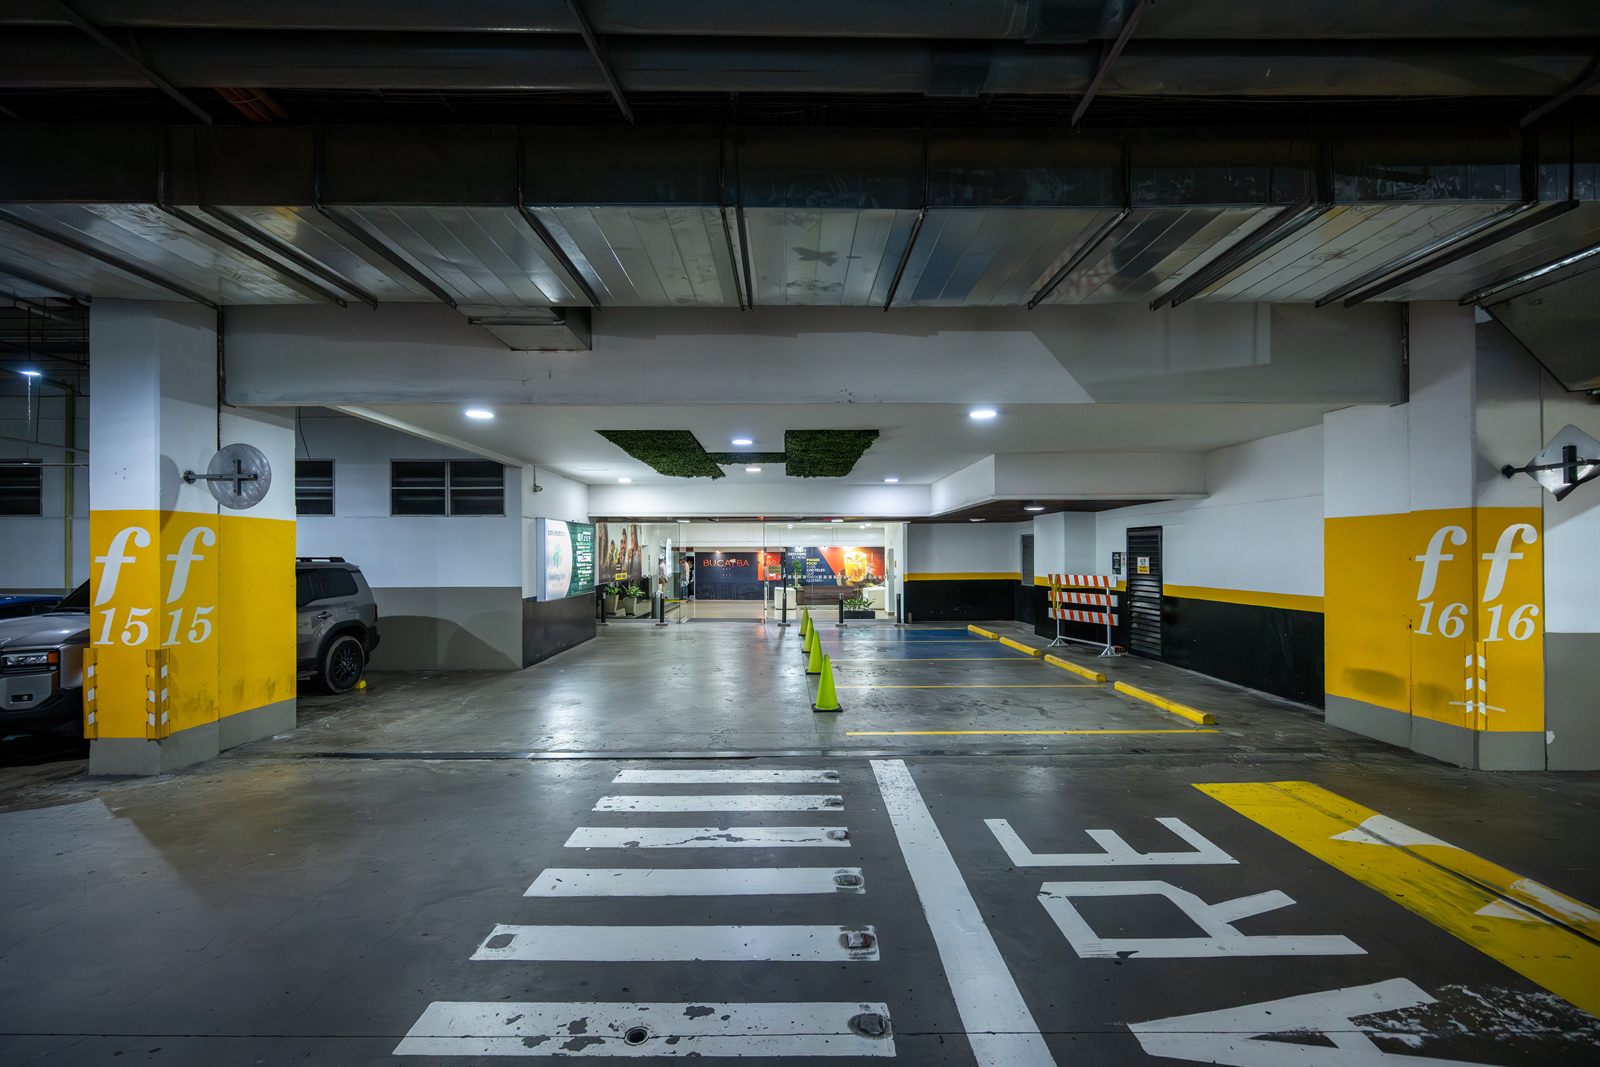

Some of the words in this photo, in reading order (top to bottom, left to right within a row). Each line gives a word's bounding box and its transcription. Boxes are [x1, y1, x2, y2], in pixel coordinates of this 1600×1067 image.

[94, 526, 151, 607] f
[165, 526, 216, 605] f
[1415, 525, 1468, 601] f
[1481, 523, 1538, 603] f
[93, 607, 153, 646] 15
[161, 605, 215, 646] 15
[1413, 601, 1469, 639] 16
[1482, 603, 1540, 642] 16
